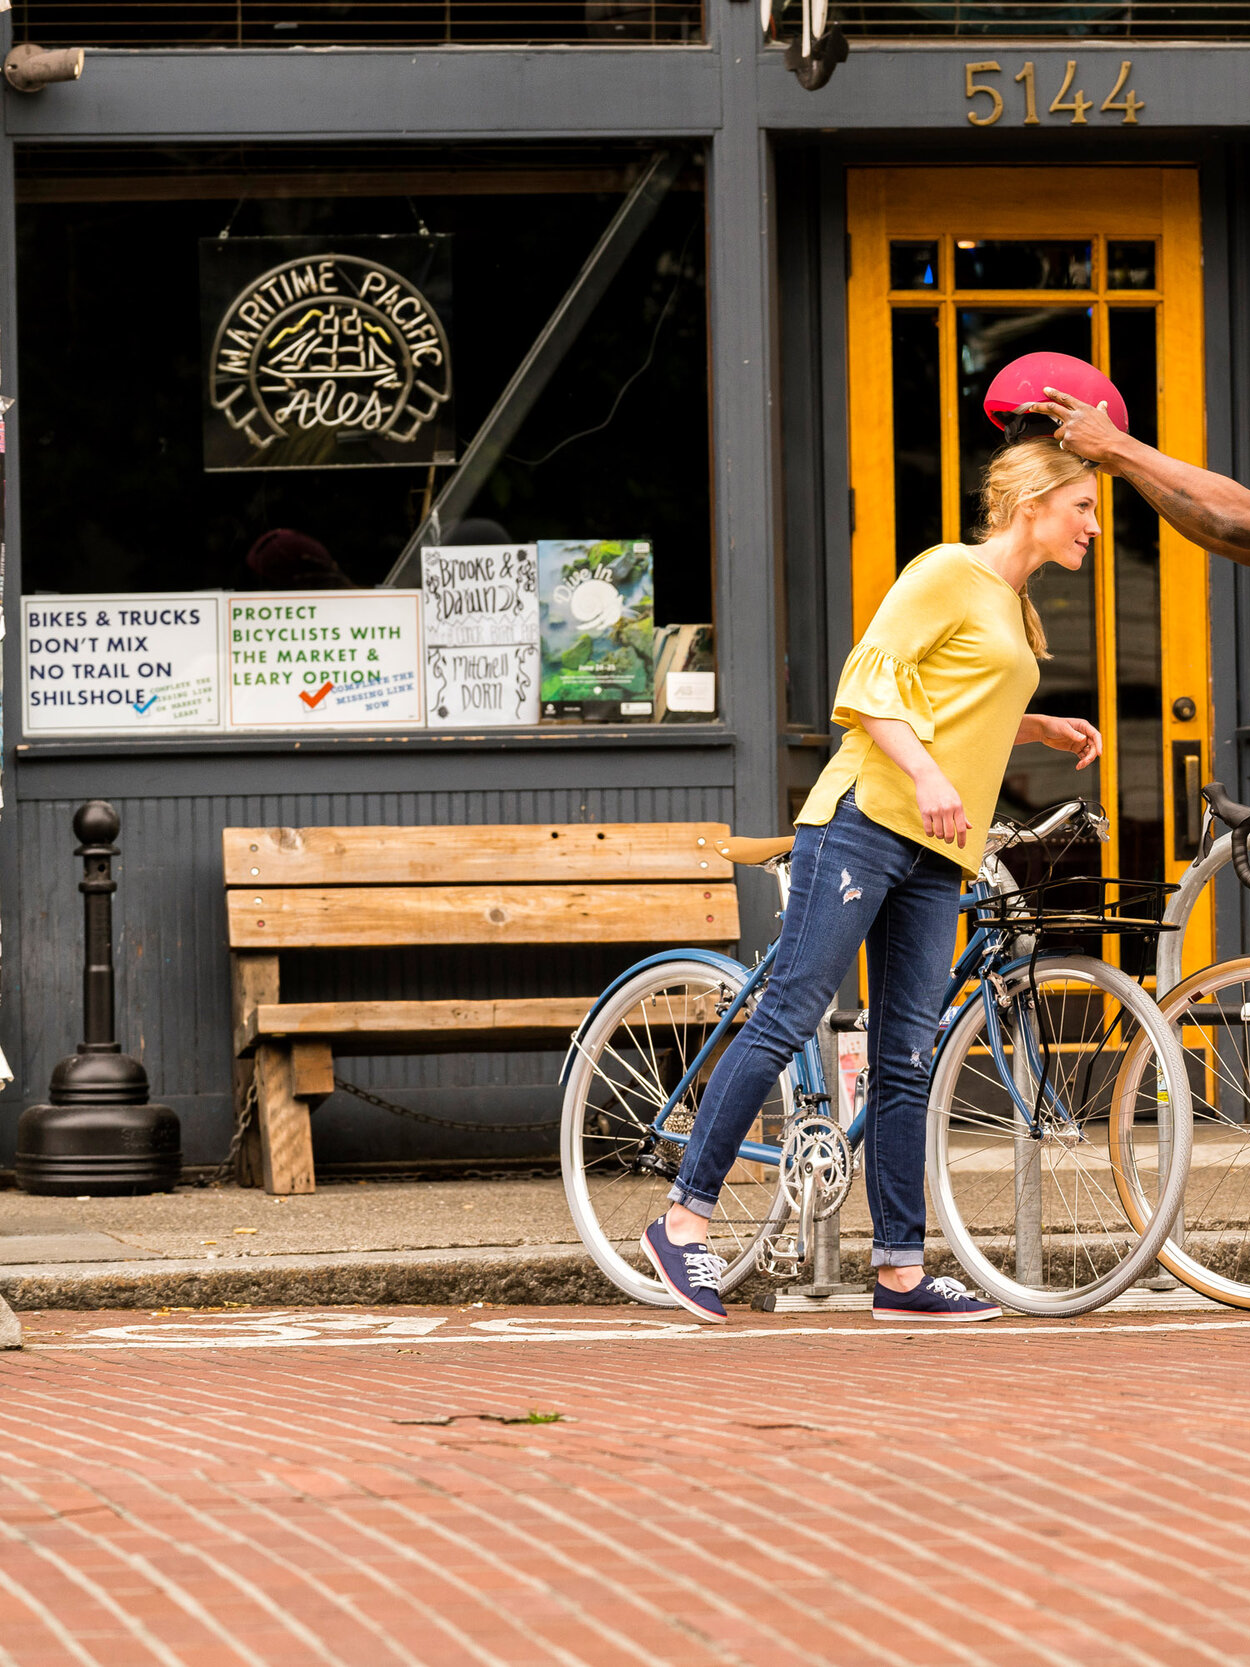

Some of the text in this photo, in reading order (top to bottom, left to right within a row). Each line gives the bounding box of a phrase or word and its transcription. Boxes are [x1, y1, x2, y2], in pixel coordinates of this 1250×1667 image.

[966, 60, 1145, 126] 5144
[217, 262, 443, 374] MARITIME PACIFIC
[276, 379, 393, 430] Ales
[500, 552, 513, 578] &
[553, 563, 613, 604] Dive In
[443, 586, 496, 619] Dawn
[29, 609, 200, 627] BIKES & TRUCKS
[233, 606, 317, 620] PROTECT
[233, 626, 401, 642] BICYCLISTS WITH
[30, 636, 148, 653] DON'T MIX
[233, 648, 379, 664] THE MARKET &
[30, 662, 172, 680] NO TRAIL ON
[233, 670, 381, 686] LEARY OPTION
[330, 672, 414, 694] COMPLETE THE
[30, 689, 144, 706] SHILSHOLE
[336, 683, 414, 705] MISSING LINK
[365, 700, 390, 711] NOW
